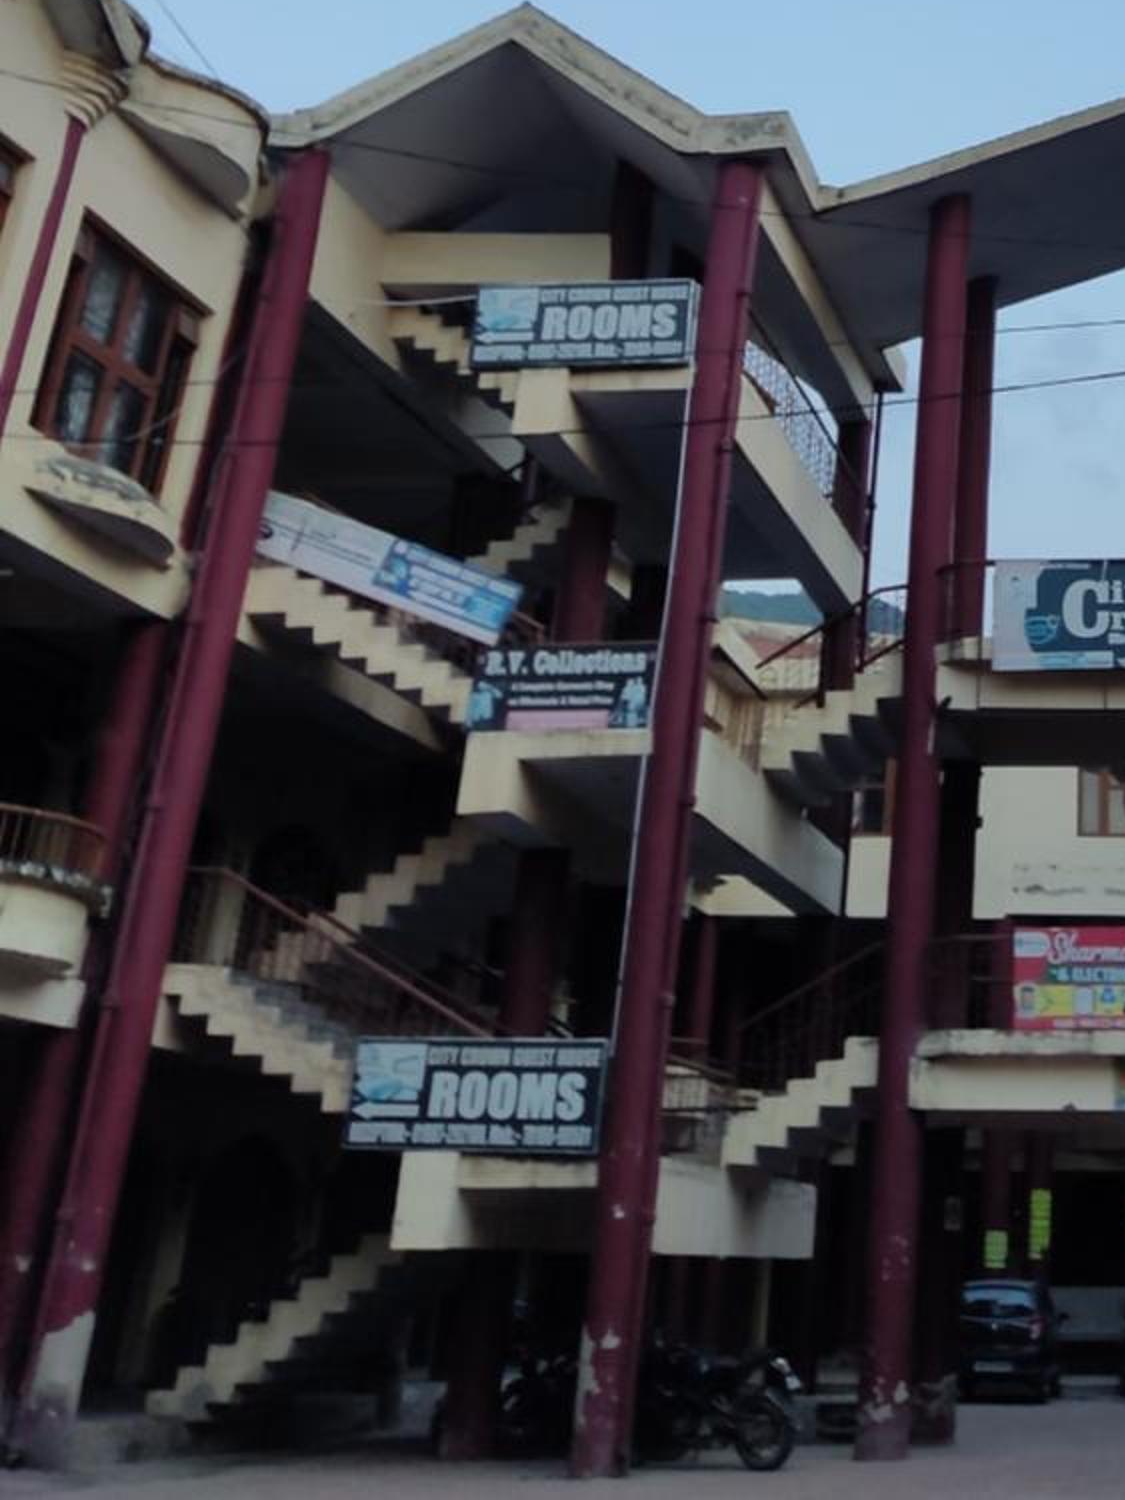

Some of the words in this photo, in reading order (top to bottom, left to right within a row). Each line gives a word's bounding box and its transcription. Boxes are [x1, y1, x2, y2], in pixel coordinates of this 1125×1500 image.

[541, 303, 678, 340] ROOMS
[534, 650, 647, 675] Collections
[427, 1070, 586, 1120] ROOMS
